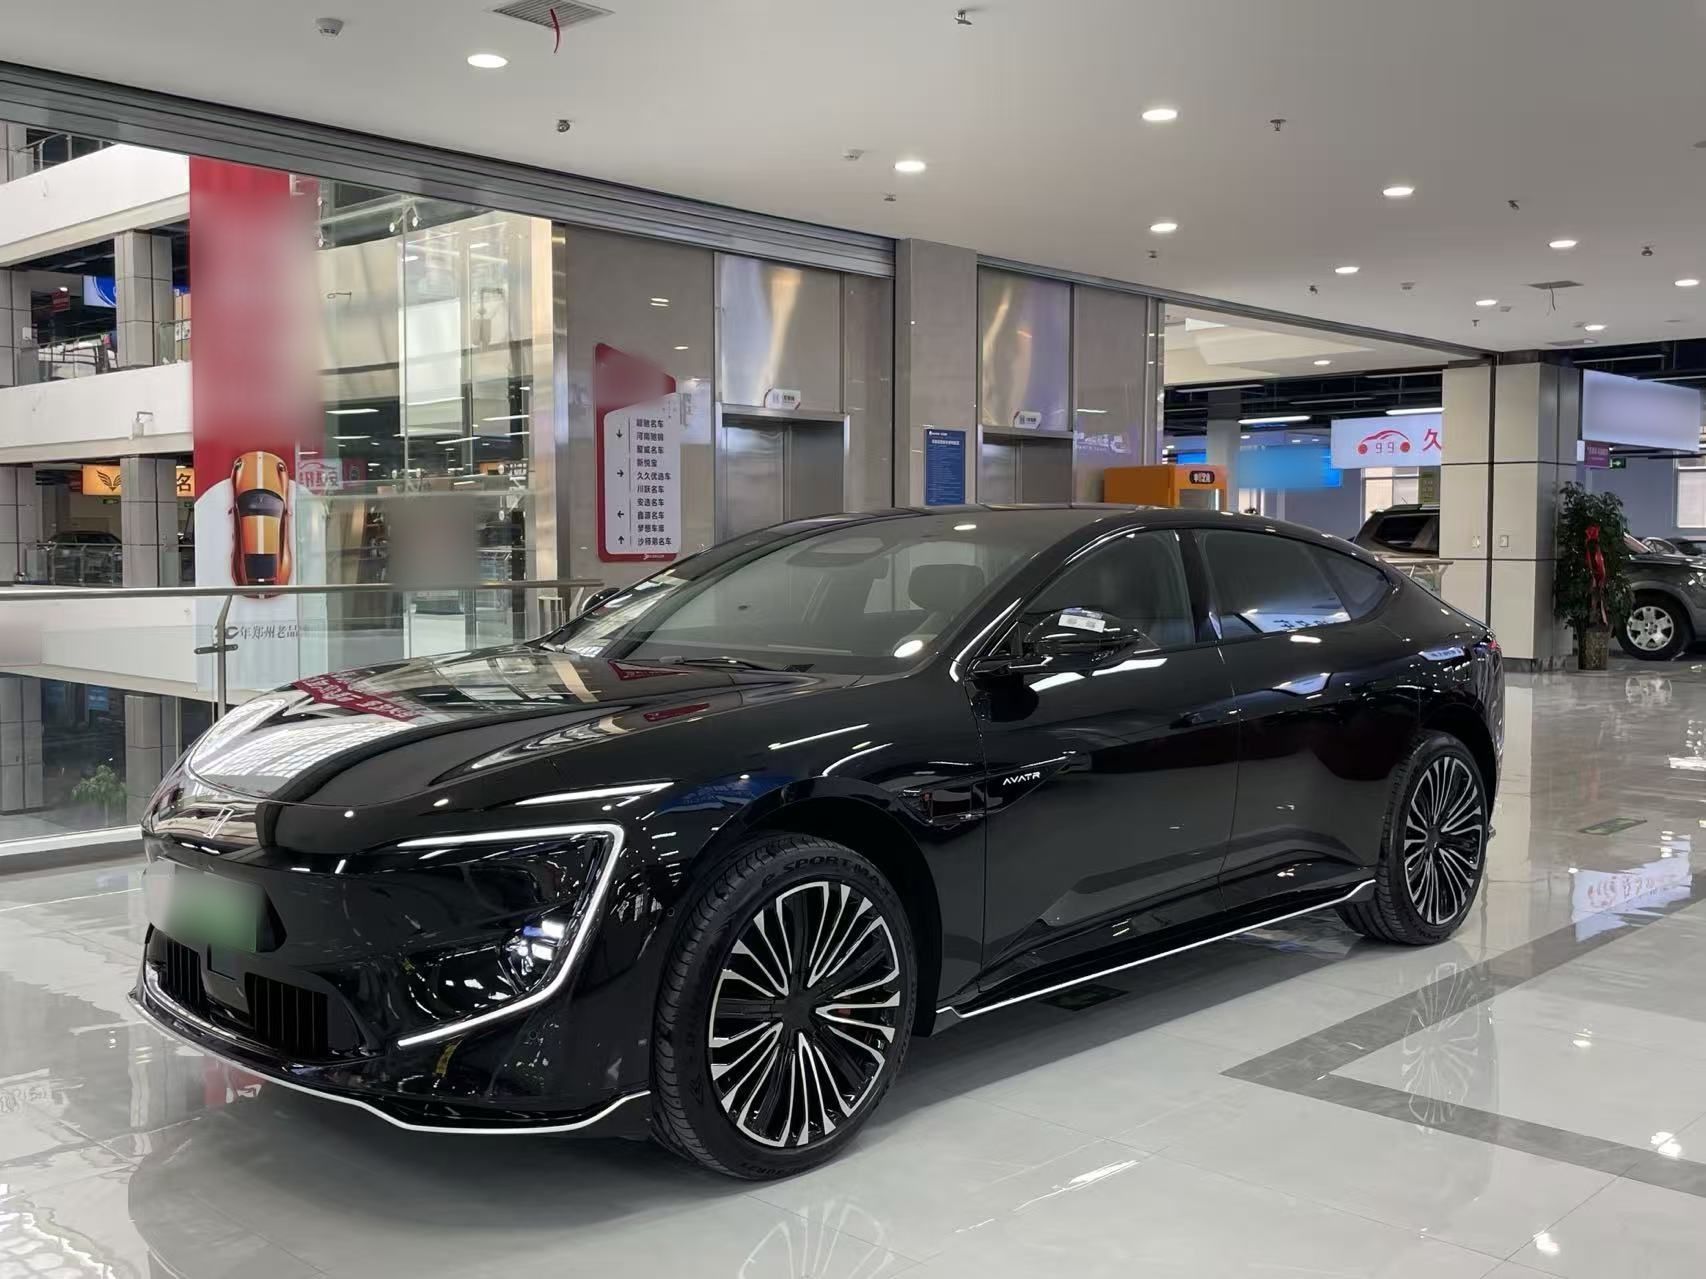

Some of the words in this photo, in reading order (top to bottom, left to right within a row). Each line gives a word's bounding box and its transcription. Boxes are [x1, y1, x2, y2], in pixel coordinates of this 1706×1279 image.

[1422, 428, 1441, 452] 久
[177, 473, 192, 492] 名
[1002, 771, 1041, 786] AVATR
